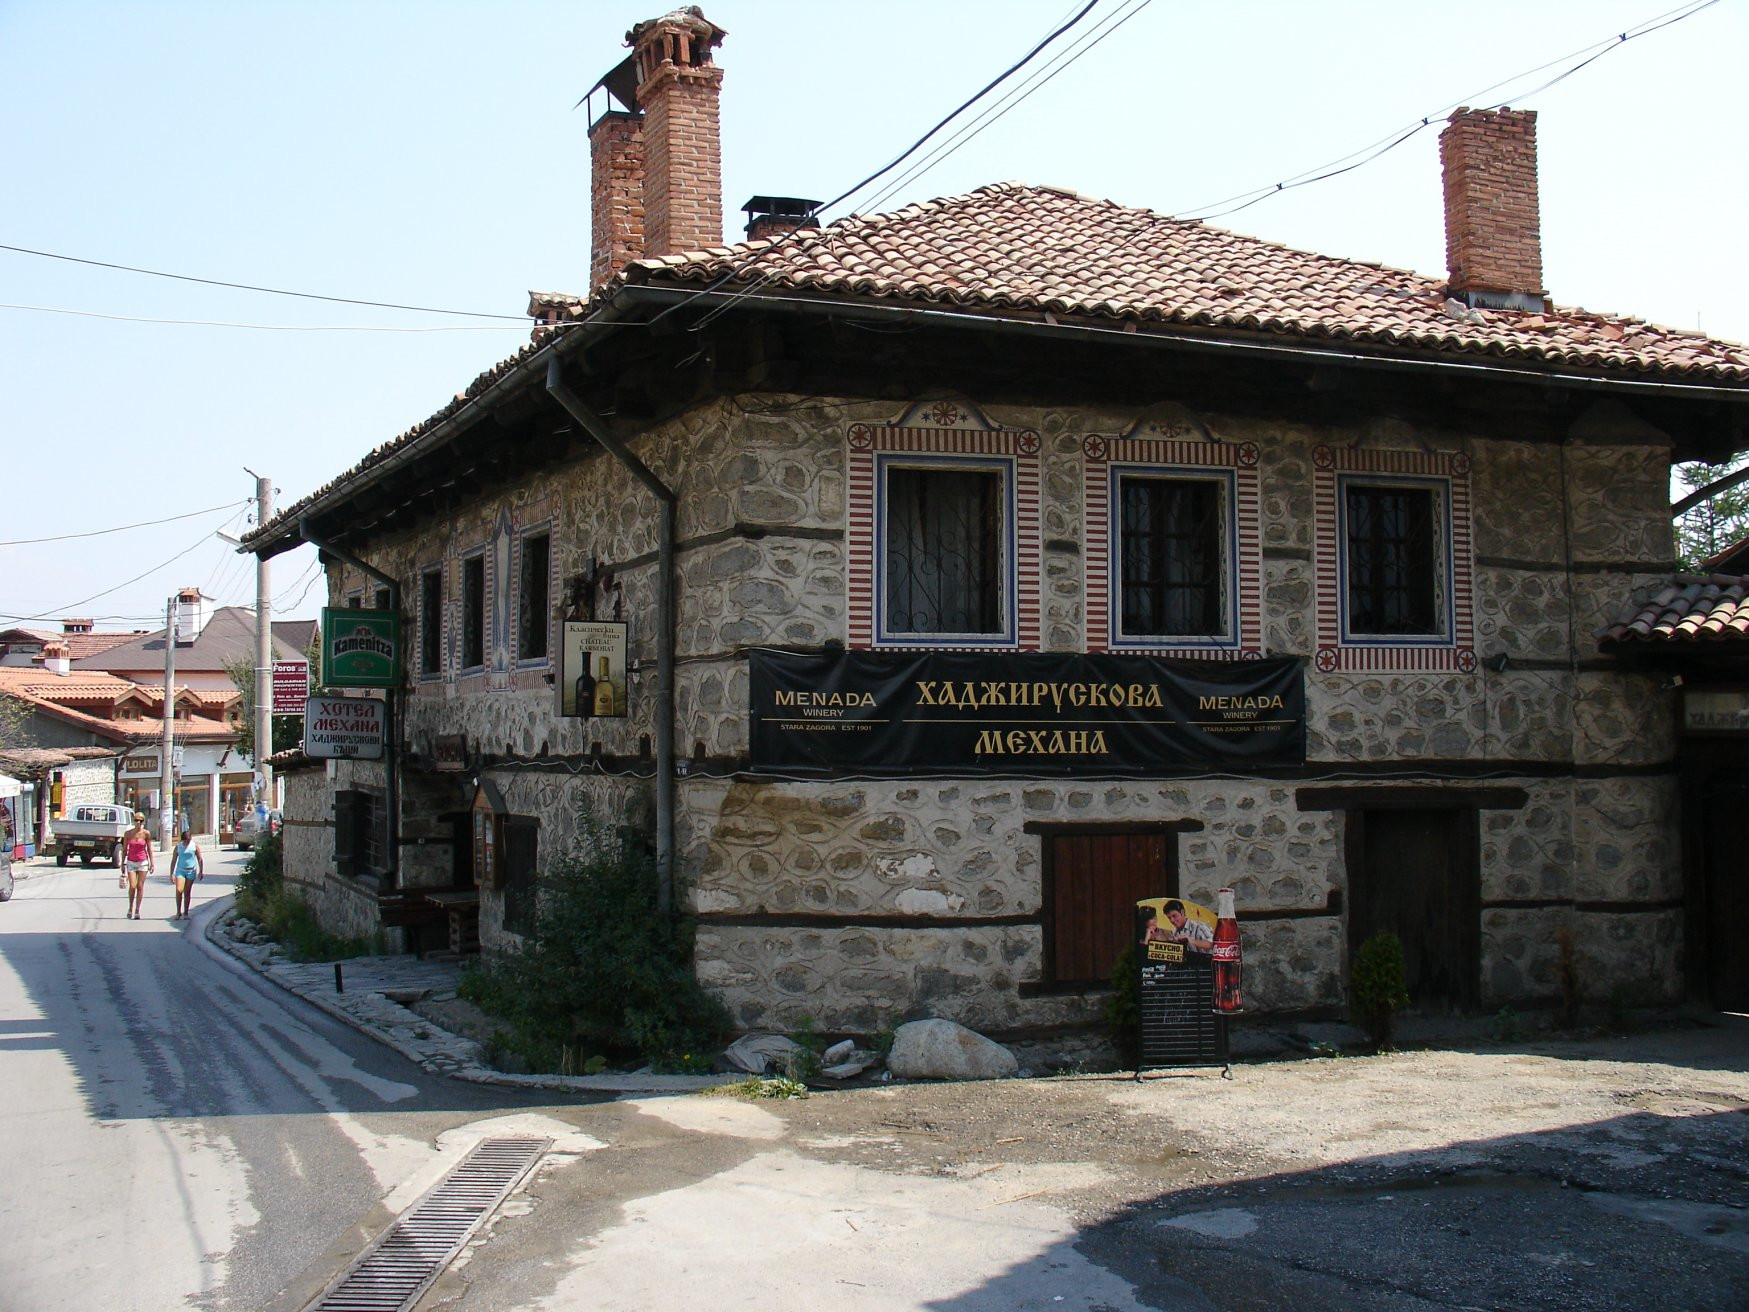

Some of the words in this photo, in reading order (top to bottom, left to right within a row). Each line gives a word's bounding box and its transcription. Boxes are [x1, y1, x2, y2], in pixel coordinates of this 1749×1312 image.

[334, 636, 393, 659] Kamenitza
[775, 690, 877, 707] MENADA
[915, 681, 1164, 714] ХАДЖИРУСКОВА
[1199, 695, 1284, 710] MENADA
[320, 702, 375, 718] ХОТЕЛ
[803, 708, 844, 717] WINERY
[1223, 711, 1258, 719] WINERY
[313, 718, 380, 733] МЕХАНА
[975, 730, 1109, 754] МЕХАНА
[127, 759, 158, 769] LOLITA
